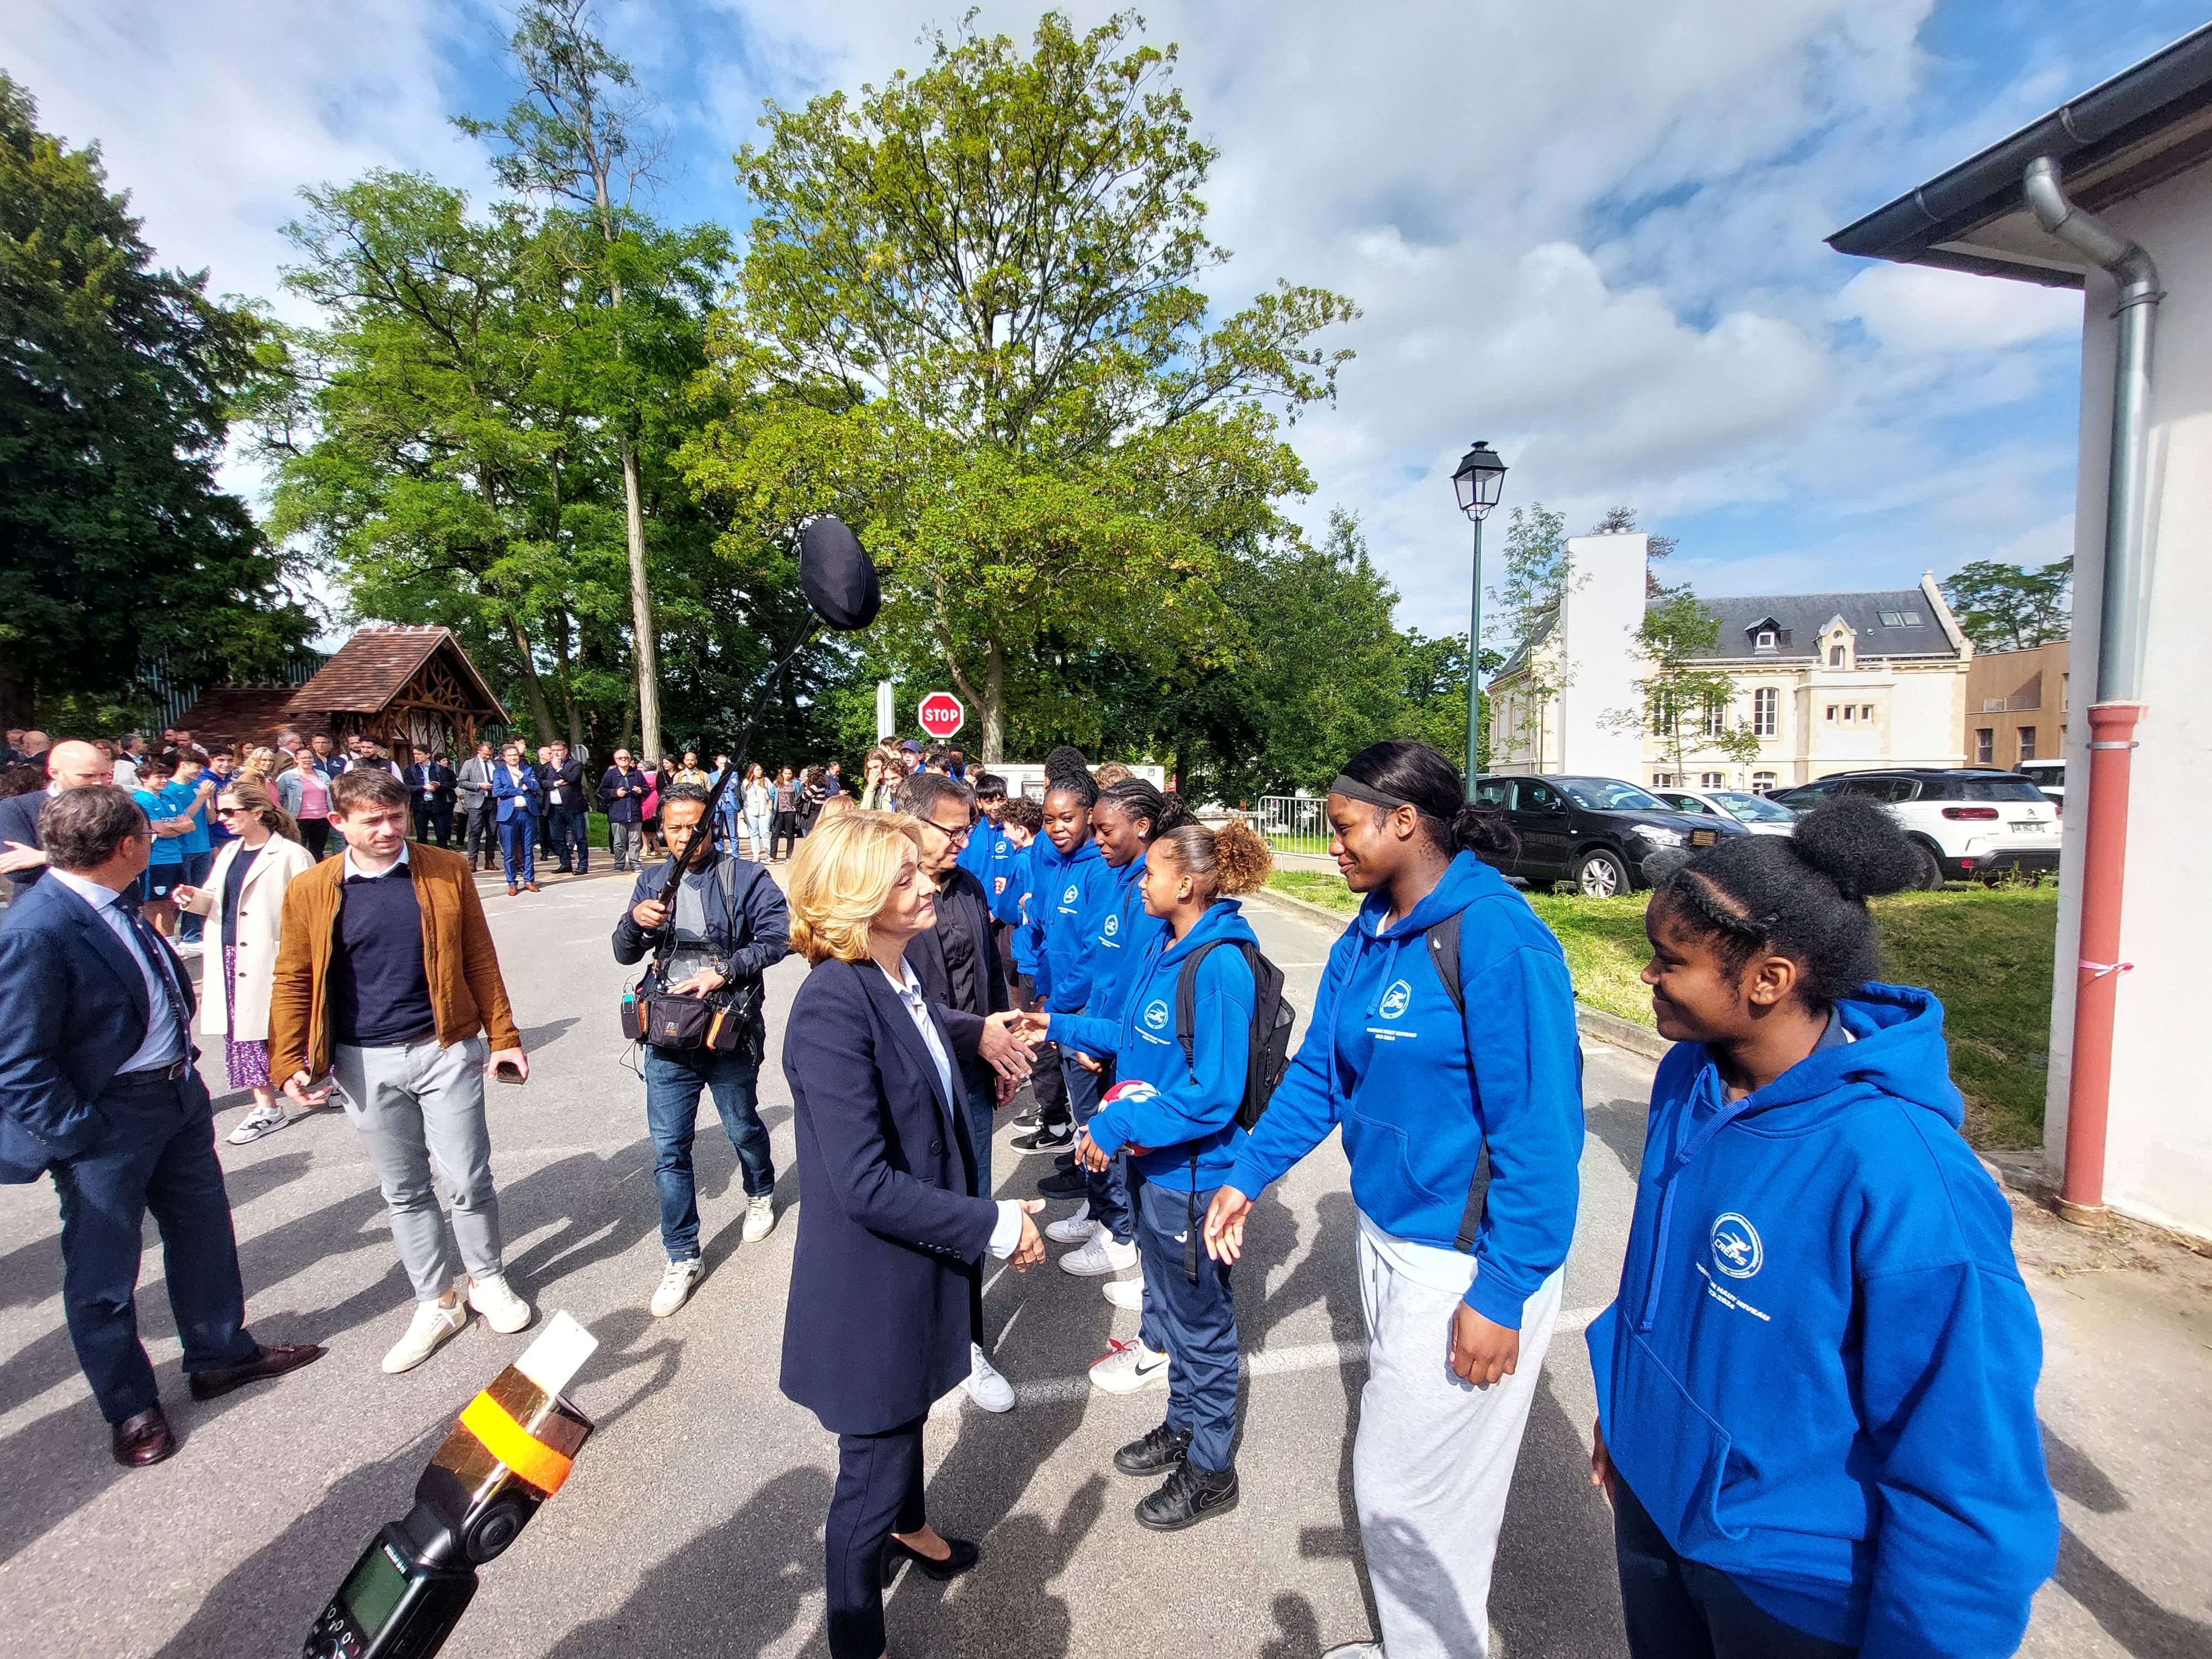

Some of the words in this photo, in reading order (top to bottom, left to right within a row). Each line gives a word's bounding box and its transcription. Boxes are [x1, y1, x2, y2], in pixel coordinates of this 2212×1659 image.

[925, 709, 958, 722] STOP
[1714, 1238, 1748, 1266] CREPS
[1717, 1286, 1738, 1302] HAUT
[1736, 1300, 1771, 1321] NIVEAU
